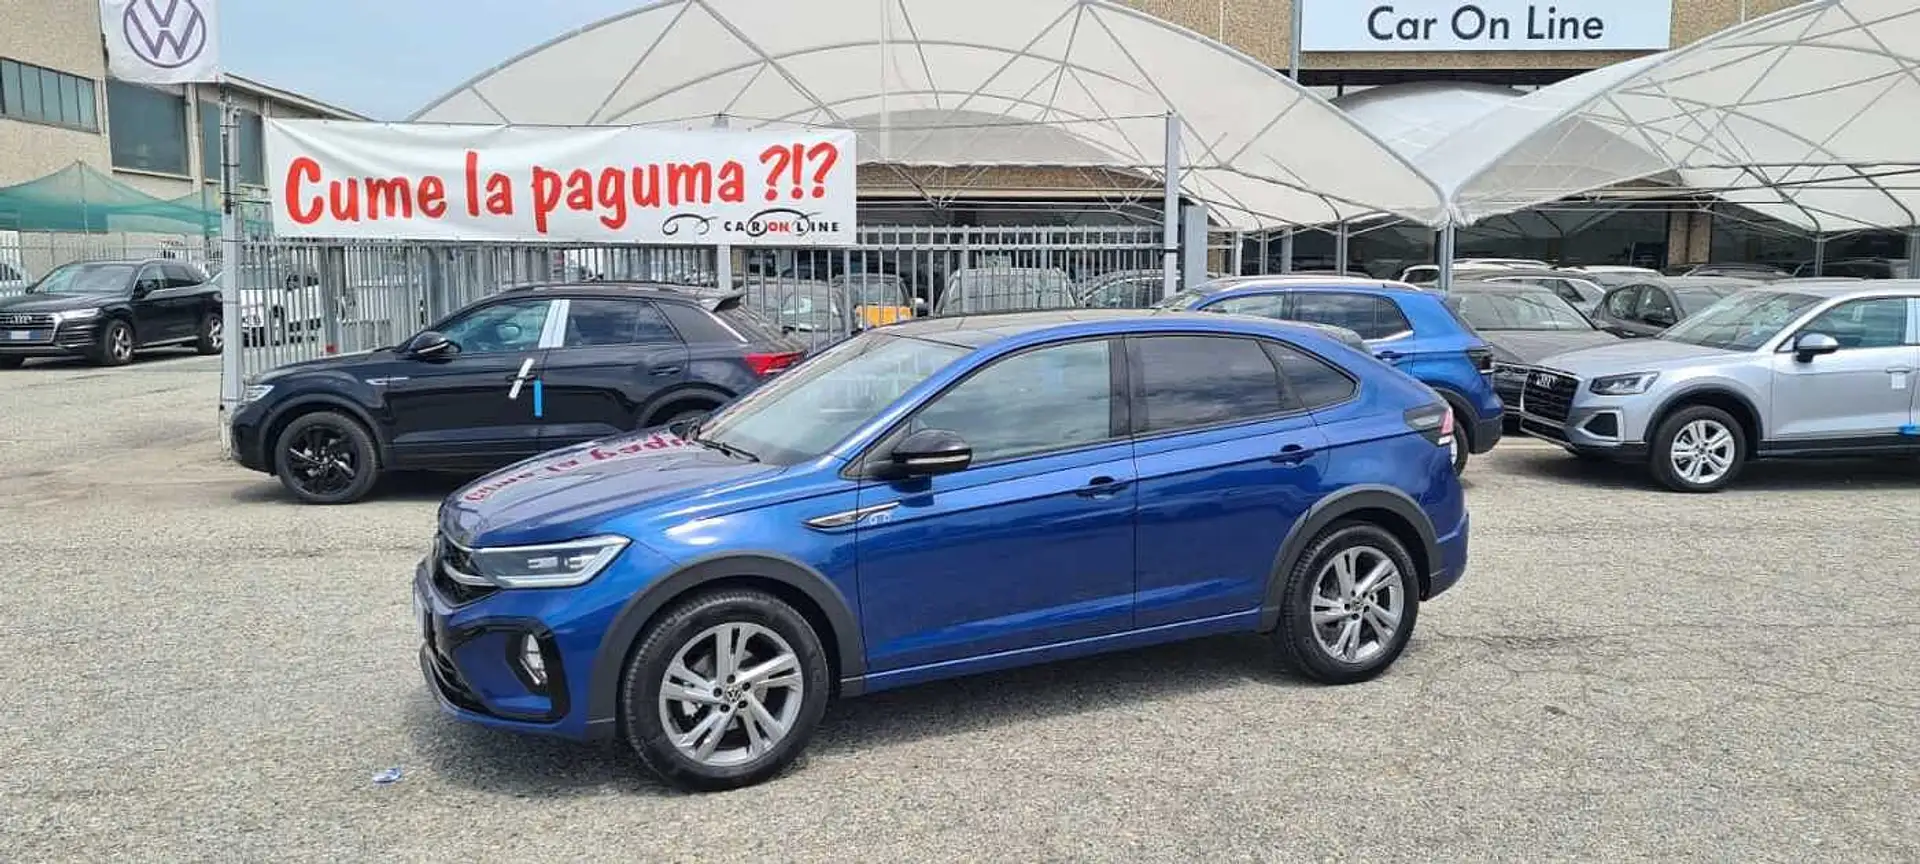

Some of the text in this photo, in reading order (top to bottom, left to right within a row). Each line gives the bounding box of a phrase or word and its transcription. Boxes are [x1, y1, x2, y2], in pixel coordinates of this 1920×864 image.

[1367, 4, 1604, 40] Car On Line
[285, 142, 838, 233] Cume la paguma ?!?
